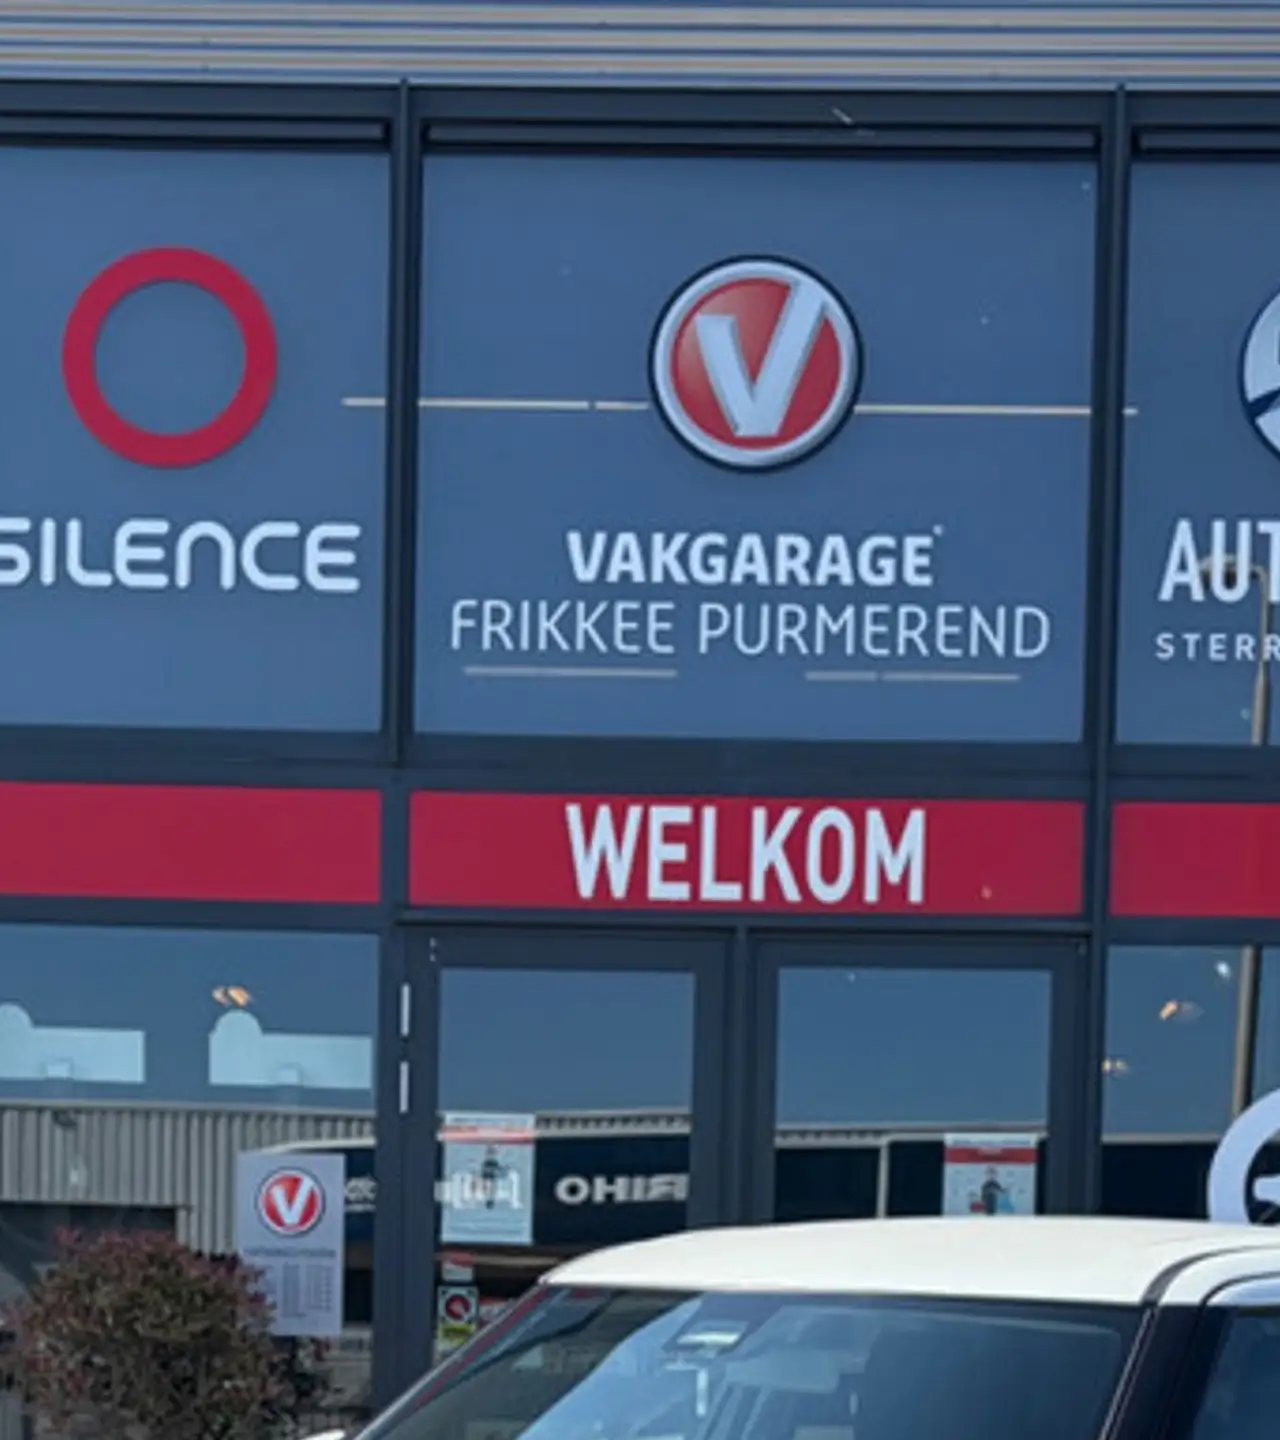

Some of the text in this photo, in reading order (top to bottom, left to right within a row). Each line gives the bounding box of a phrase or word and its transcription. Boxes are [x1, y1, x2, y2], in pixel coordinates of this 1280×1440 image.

[567, 531, 934, 586] VAKGARAGE
[451, 599, 1050, 657] FRIKKEE PURMEREND
[565, 804, 925, 903] WELKOM
